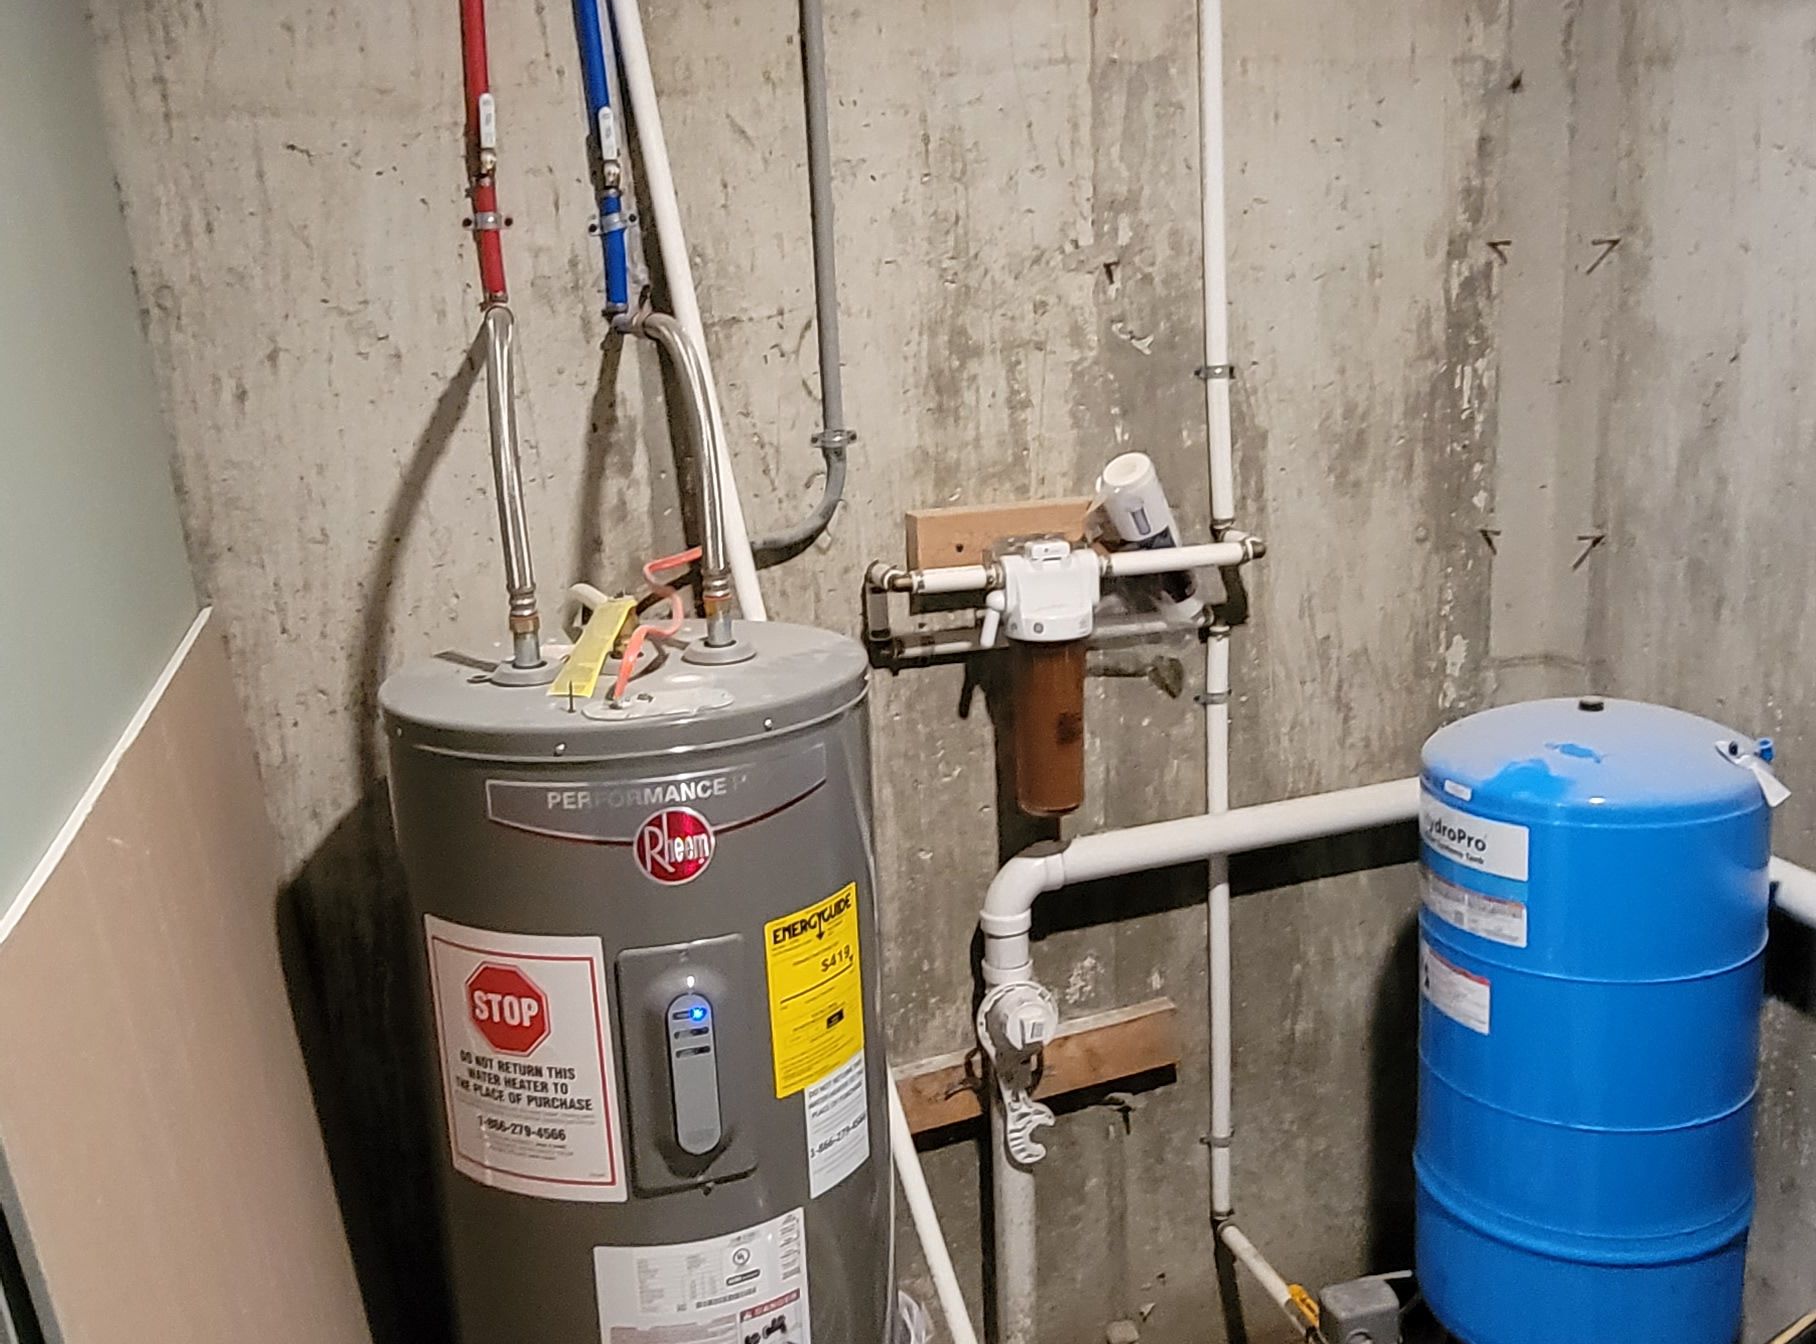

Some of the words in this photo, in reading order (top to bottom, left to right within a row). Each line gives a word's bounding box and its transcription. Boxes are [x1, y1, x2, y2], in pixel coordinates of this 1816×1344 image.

[643, 812, 710, 873] Rheem
[473, 990, 539, 1028] STOP
[460, 1049, 473, 1065] DO
[475, 1055, 494, 1070] NOT
[498, 1060, 543, 1078] RETURN
[546, 1066, 576, 1080] THIS
[467, 1067, 501, 1086] WATER
[504, 1076, 549, 1094] HEATER
[553, 1081, 569, 1095] TO
[456, 1075, 471, 1092] THE
[473, 1082, 505, 1102] PLACE
[508, 1091, 523, 1105] OF
[527, 1094, 593, 1111] PURCHASE
